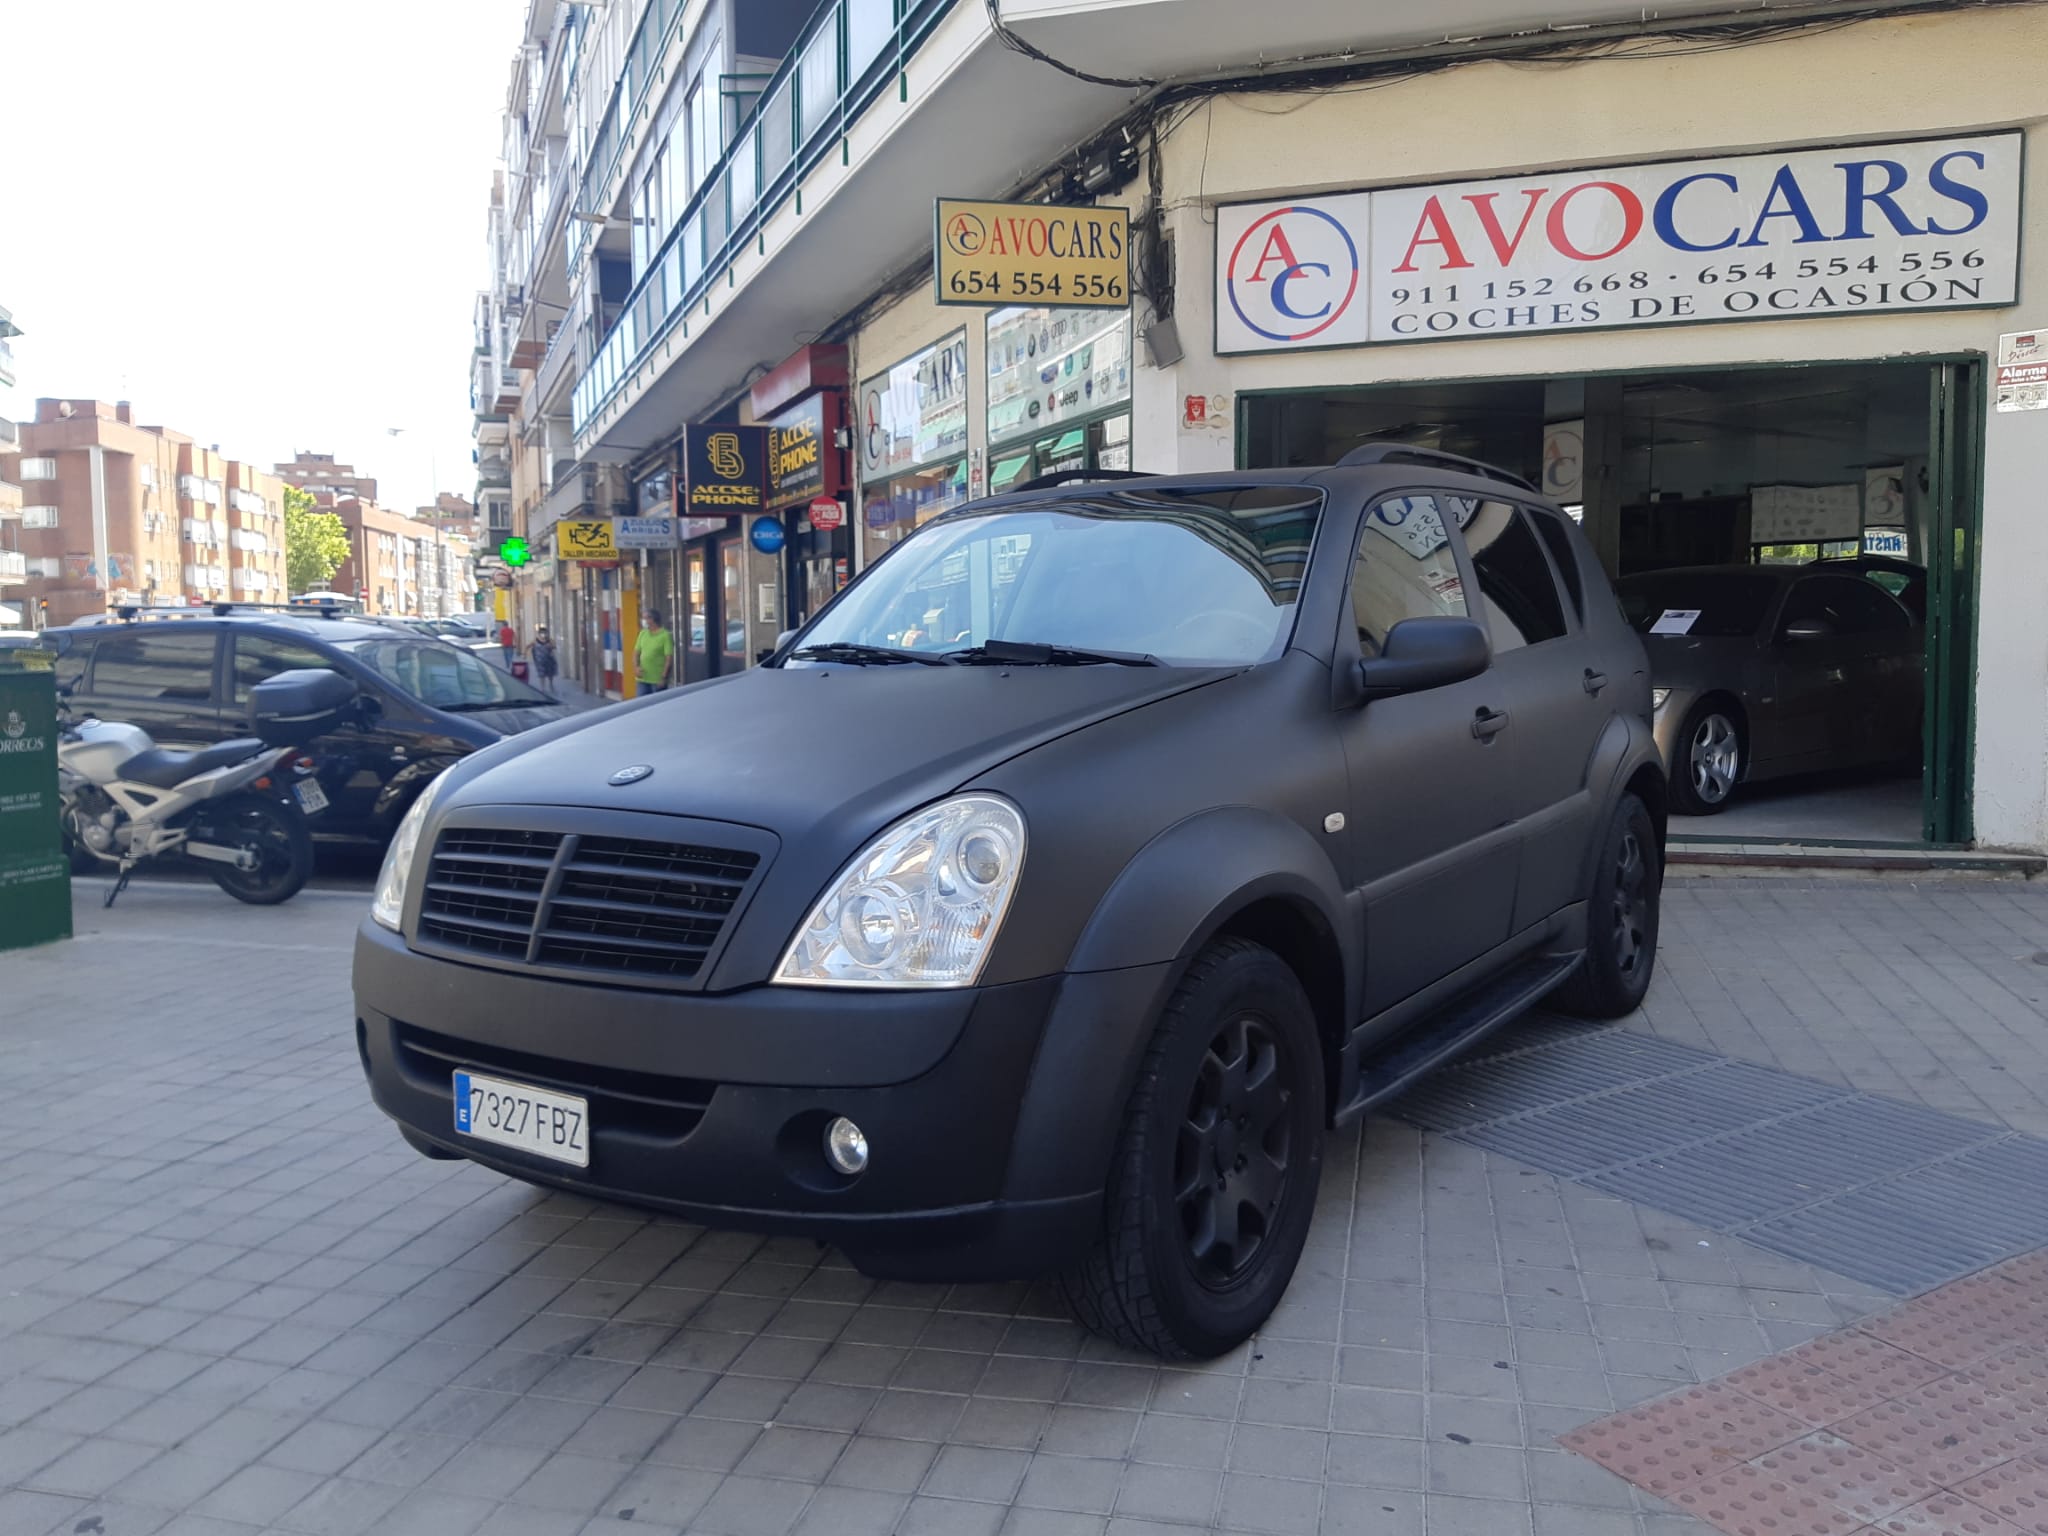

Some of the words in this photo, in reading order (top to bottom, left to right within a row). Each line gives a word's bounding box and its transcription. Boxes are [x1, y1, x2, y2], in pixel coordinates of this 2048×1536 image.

[1391, 150, 1989, 273] AVOCARS
[989, 216, 1122, 260] AVOCARS
[951, 270, 1001, 295] 654
[1012, 272, 1062, 296] 554
[1072, 274, 1122, 299] 556
[1391, 285, 1460, 305] 911
[1483, 278, 1553, 300] 152
[1573, 271, 1649, 293] 668
[1698, 262, 1776, 284] 654
[1797, 255, 1879, 278] 554
[1899, 248, 1985, 272] 556
[1391, 300, 1600, 334] COCHES
[1629, 295, 1696, 319] DE
[1723, 274, 1984, 312] OCASIÓN
[2001, 366, 2047, 378] Alarma
[780, 439, 817, 476] PHONE
[692, 495, 760, 505] PHONE
[563, 550, 584, 558] TALLER
[459, 1108, 468, 1123] E
[470, 1088, 530, 1134] 7327
[536, 1103, 583, 1150] FBZ
